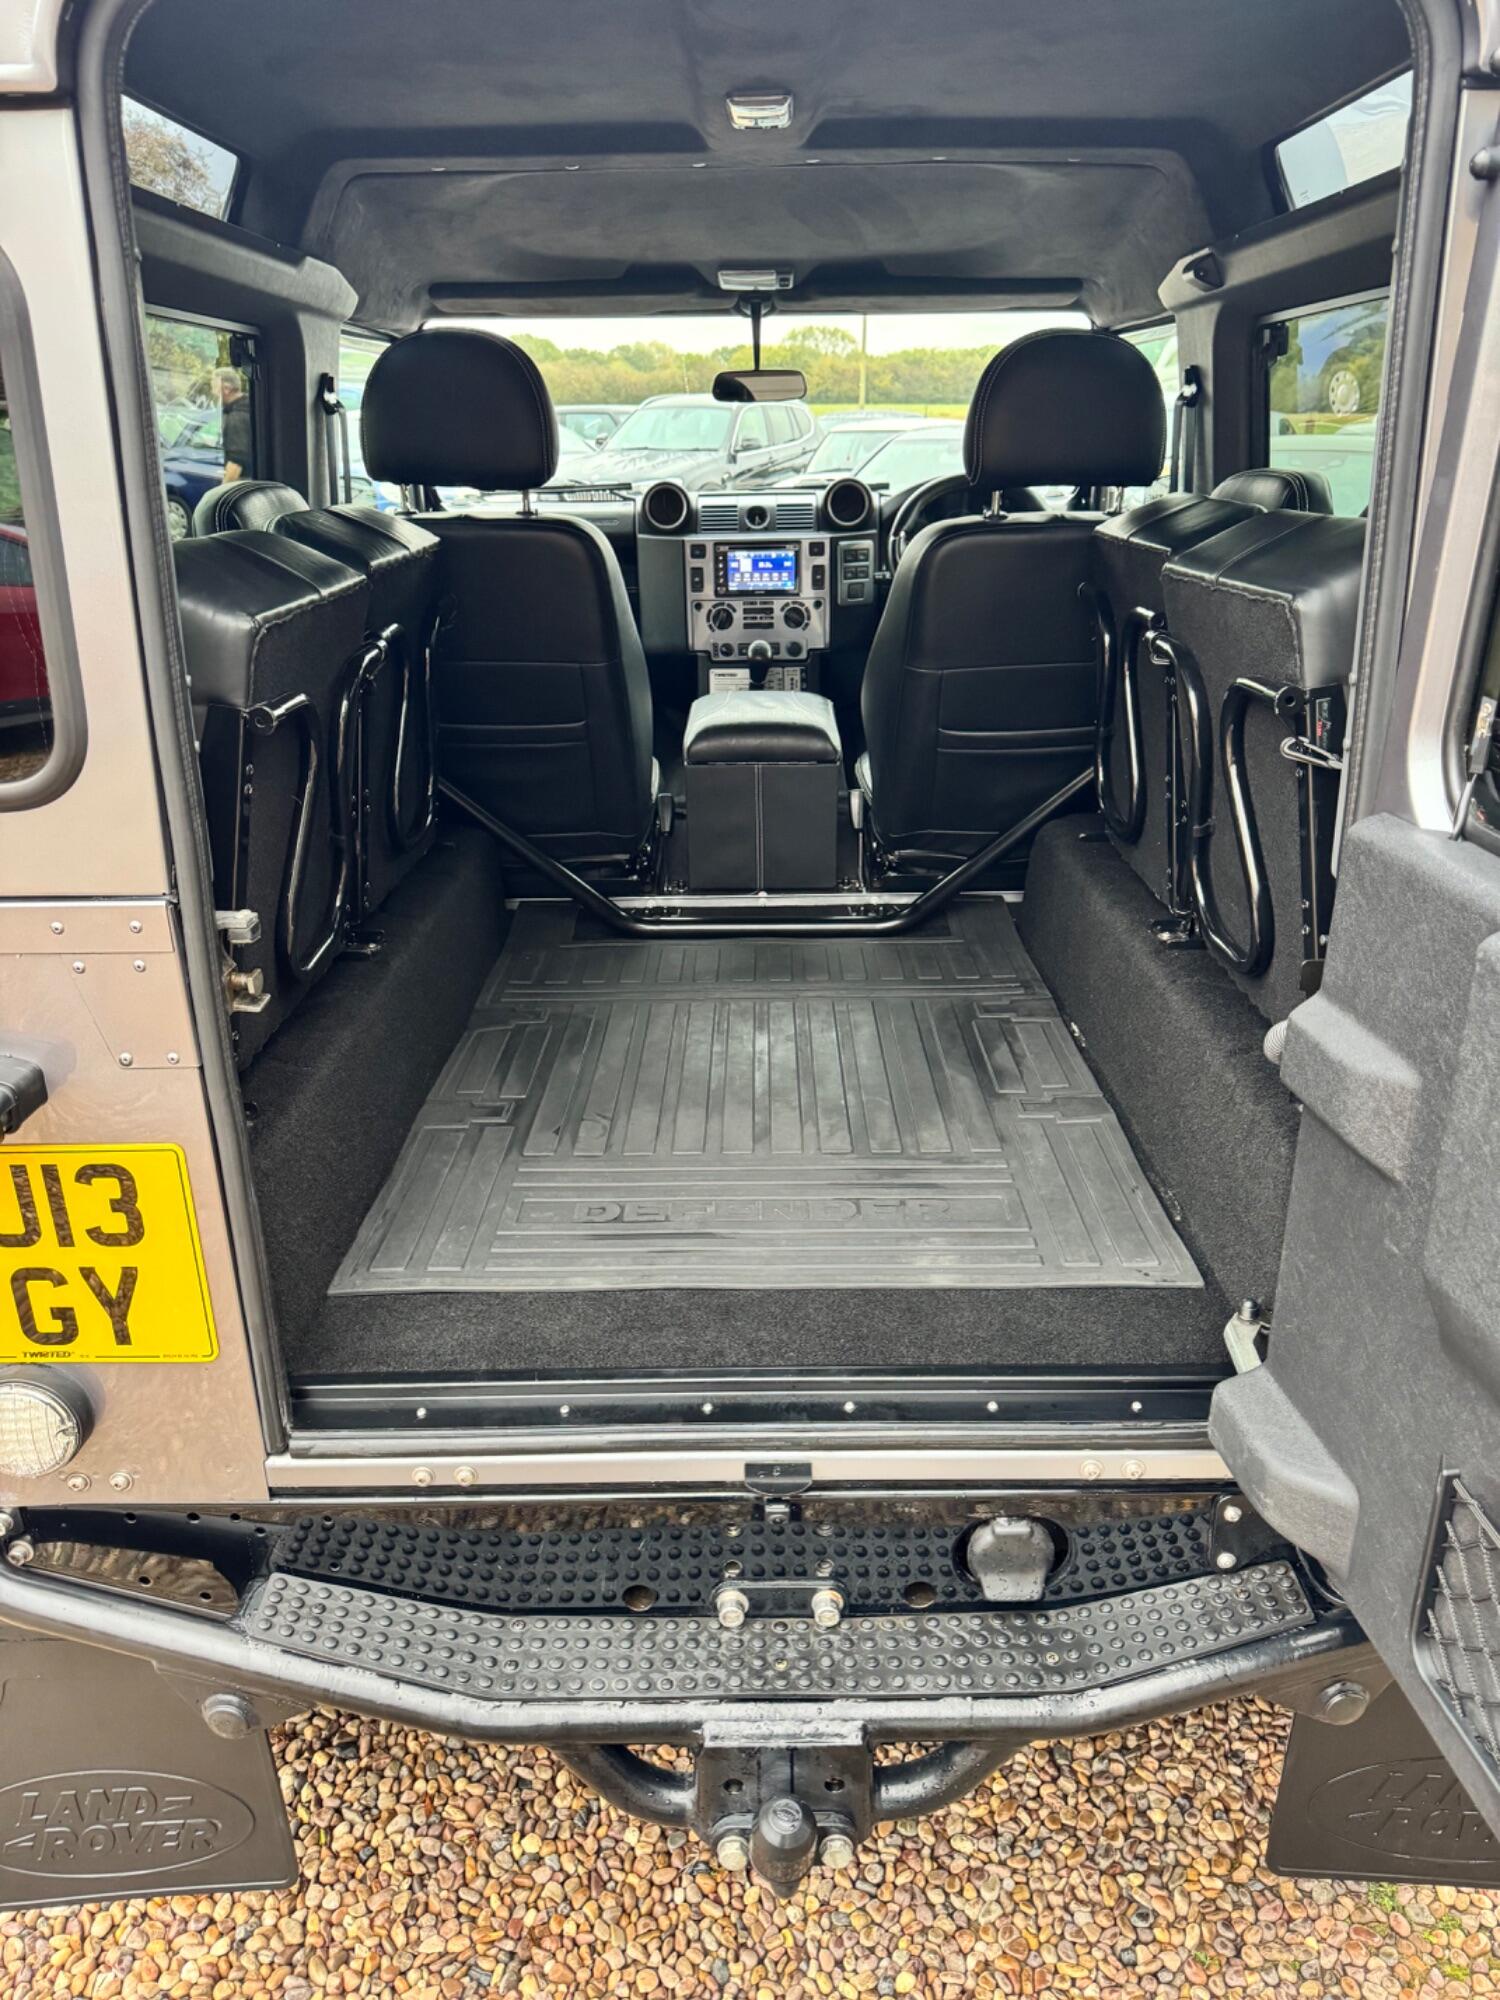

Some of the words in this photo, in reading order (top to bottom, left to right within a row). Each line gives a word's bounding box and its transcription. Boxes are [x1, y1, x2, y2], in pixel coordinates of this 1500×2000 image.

[572, 1198, 952, 1223] DEFENDER
[15, 1786, 157, 1827] LAND
[37, 1818, 223, 1861] ROVER
